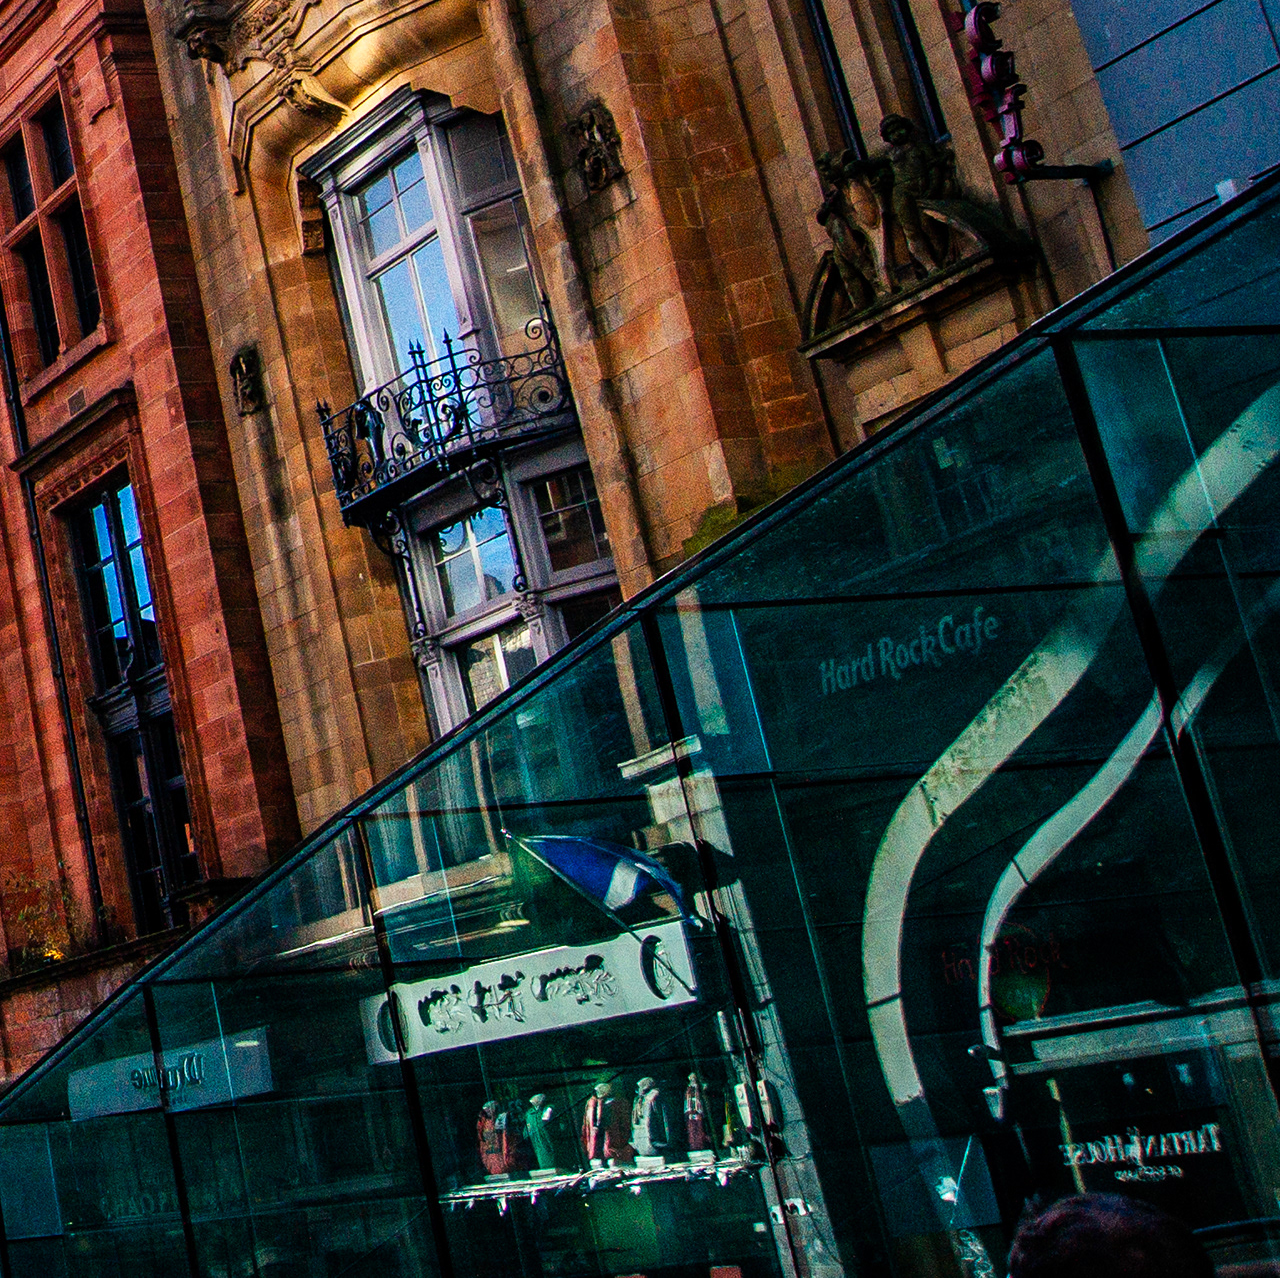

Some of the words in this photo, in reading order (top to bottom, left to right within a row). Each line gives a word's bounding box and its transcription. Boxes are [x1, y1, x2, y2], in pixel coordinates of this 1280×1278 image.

[818, 642, 876, 697] Hard
[877, 624, 943, 681] Rock
[938, 605, 1000, 656] Cafe
[941, 935, 1002, 985] Had
